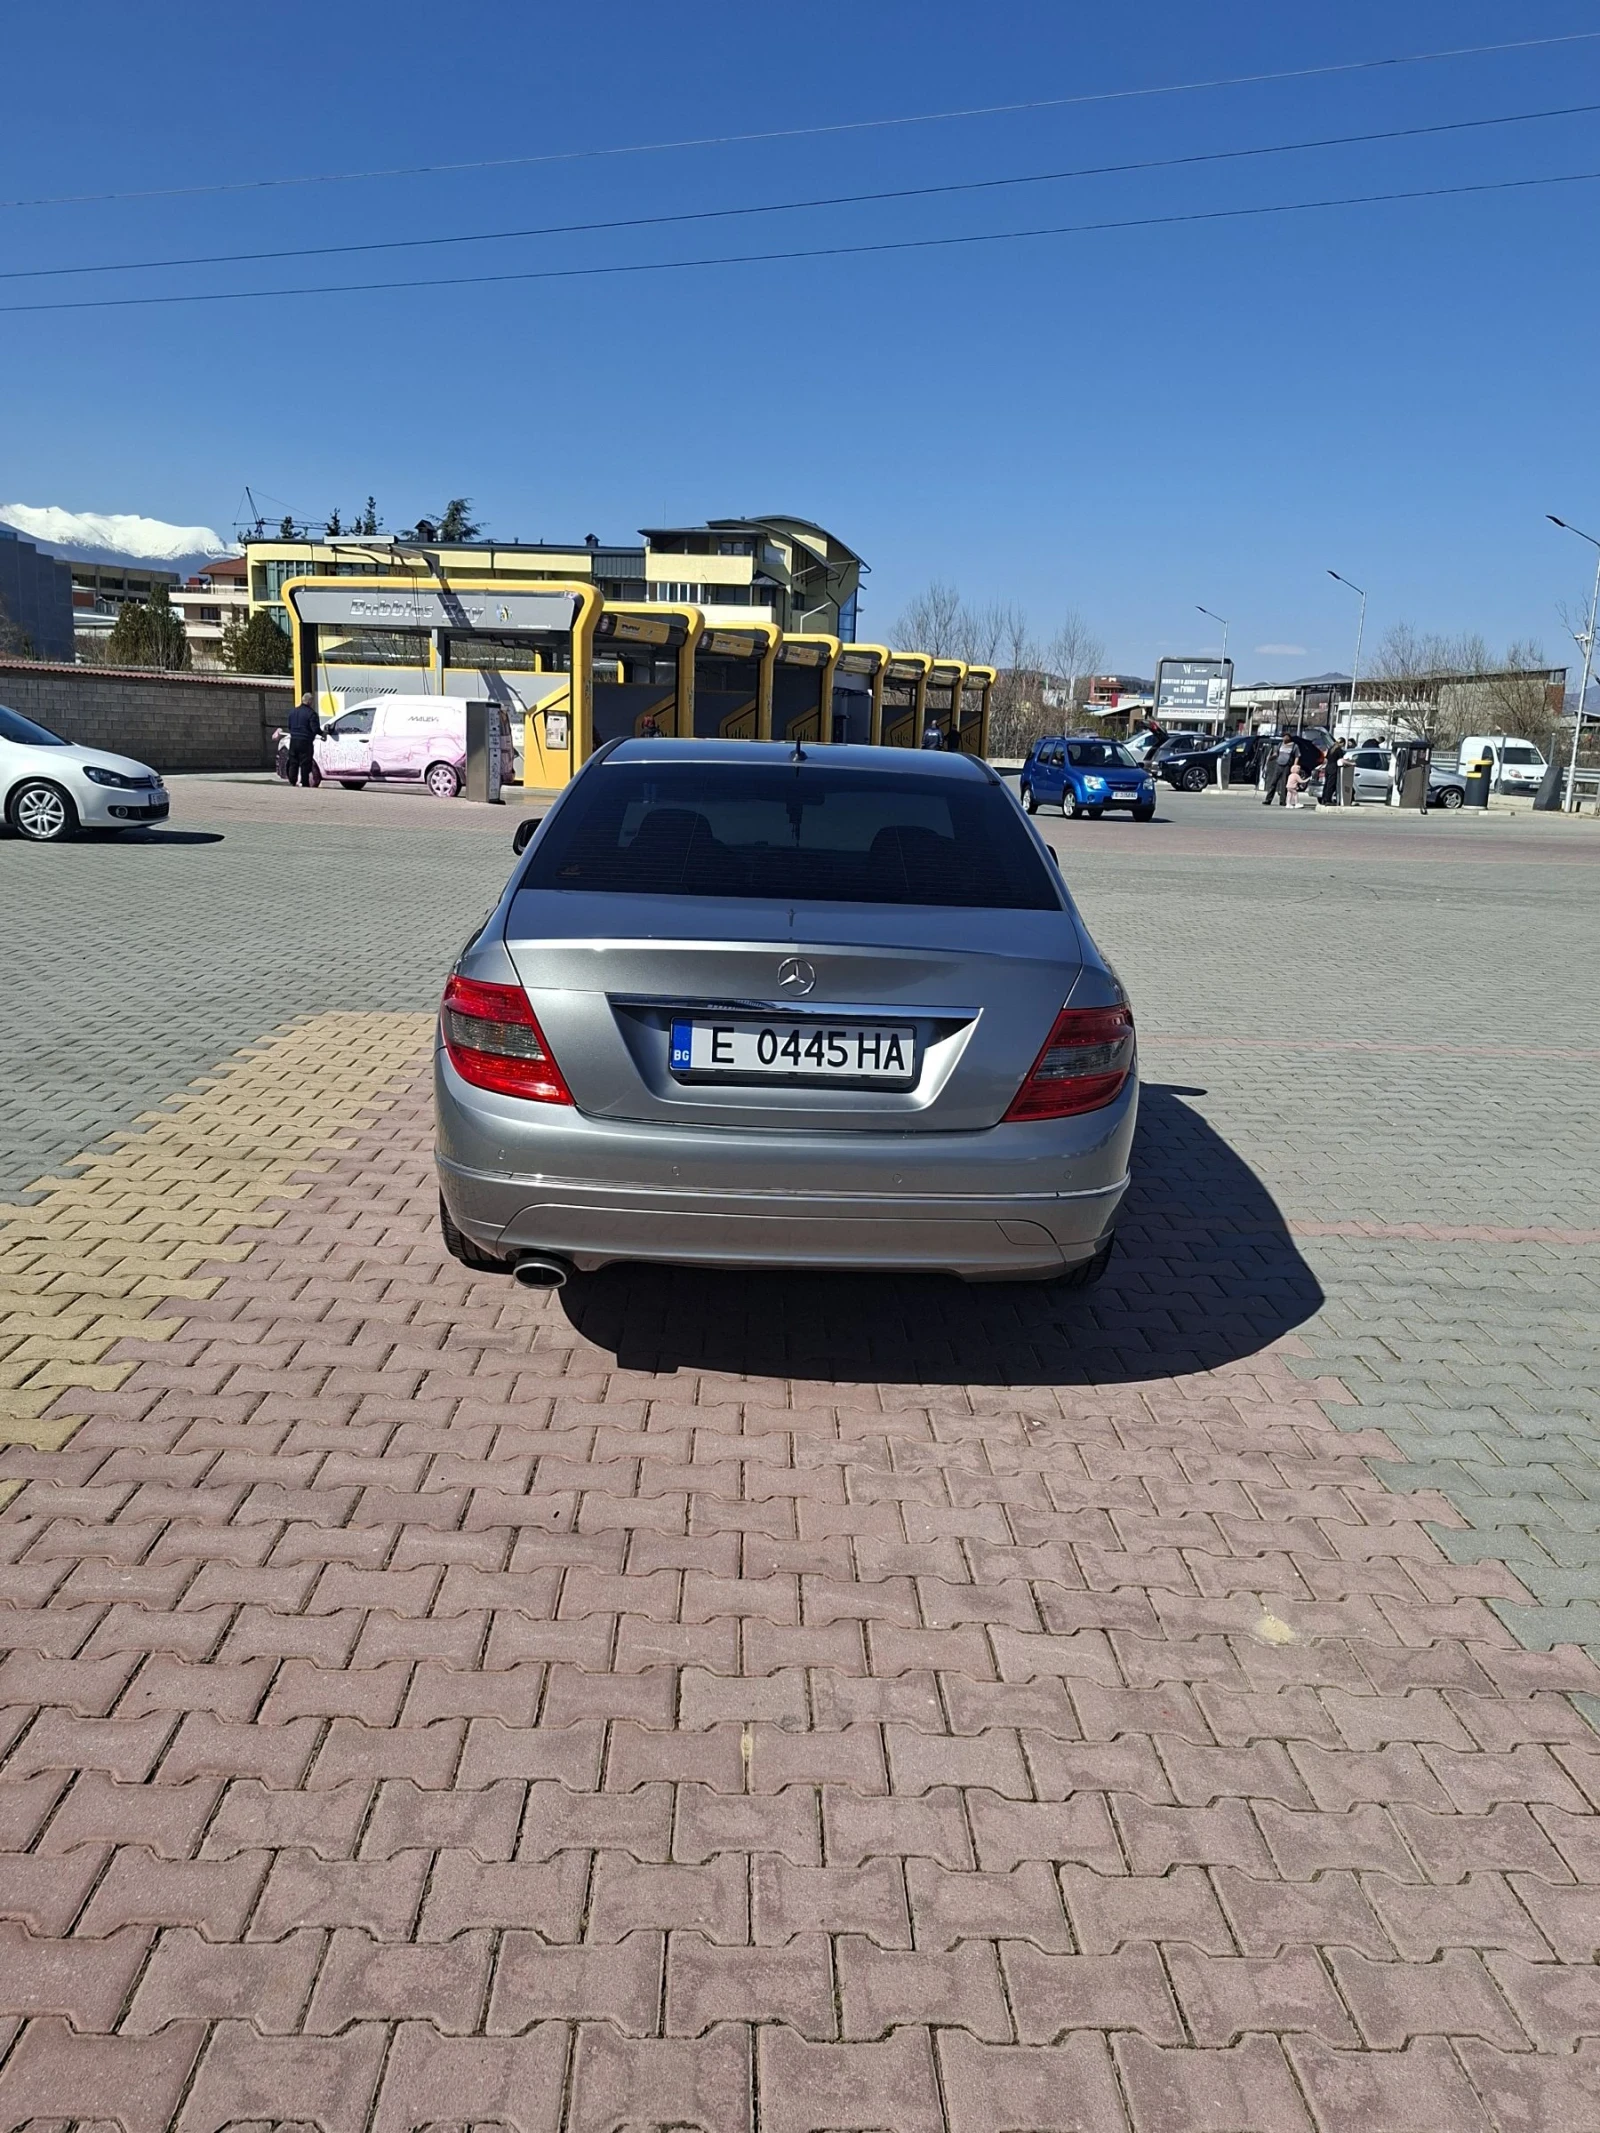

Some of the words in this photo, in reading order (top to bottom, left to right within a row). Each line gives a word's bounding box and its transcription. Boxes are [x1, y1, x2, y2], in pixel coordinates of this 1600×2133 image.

[350, 598, 434, 617] Bubbles
[673, 1049, 690, 1061] BG
[711, 1027, 735, 1063] E
[756, 1028, 848, 1068] 0445
[857, 1032, 905, 1070] HA
